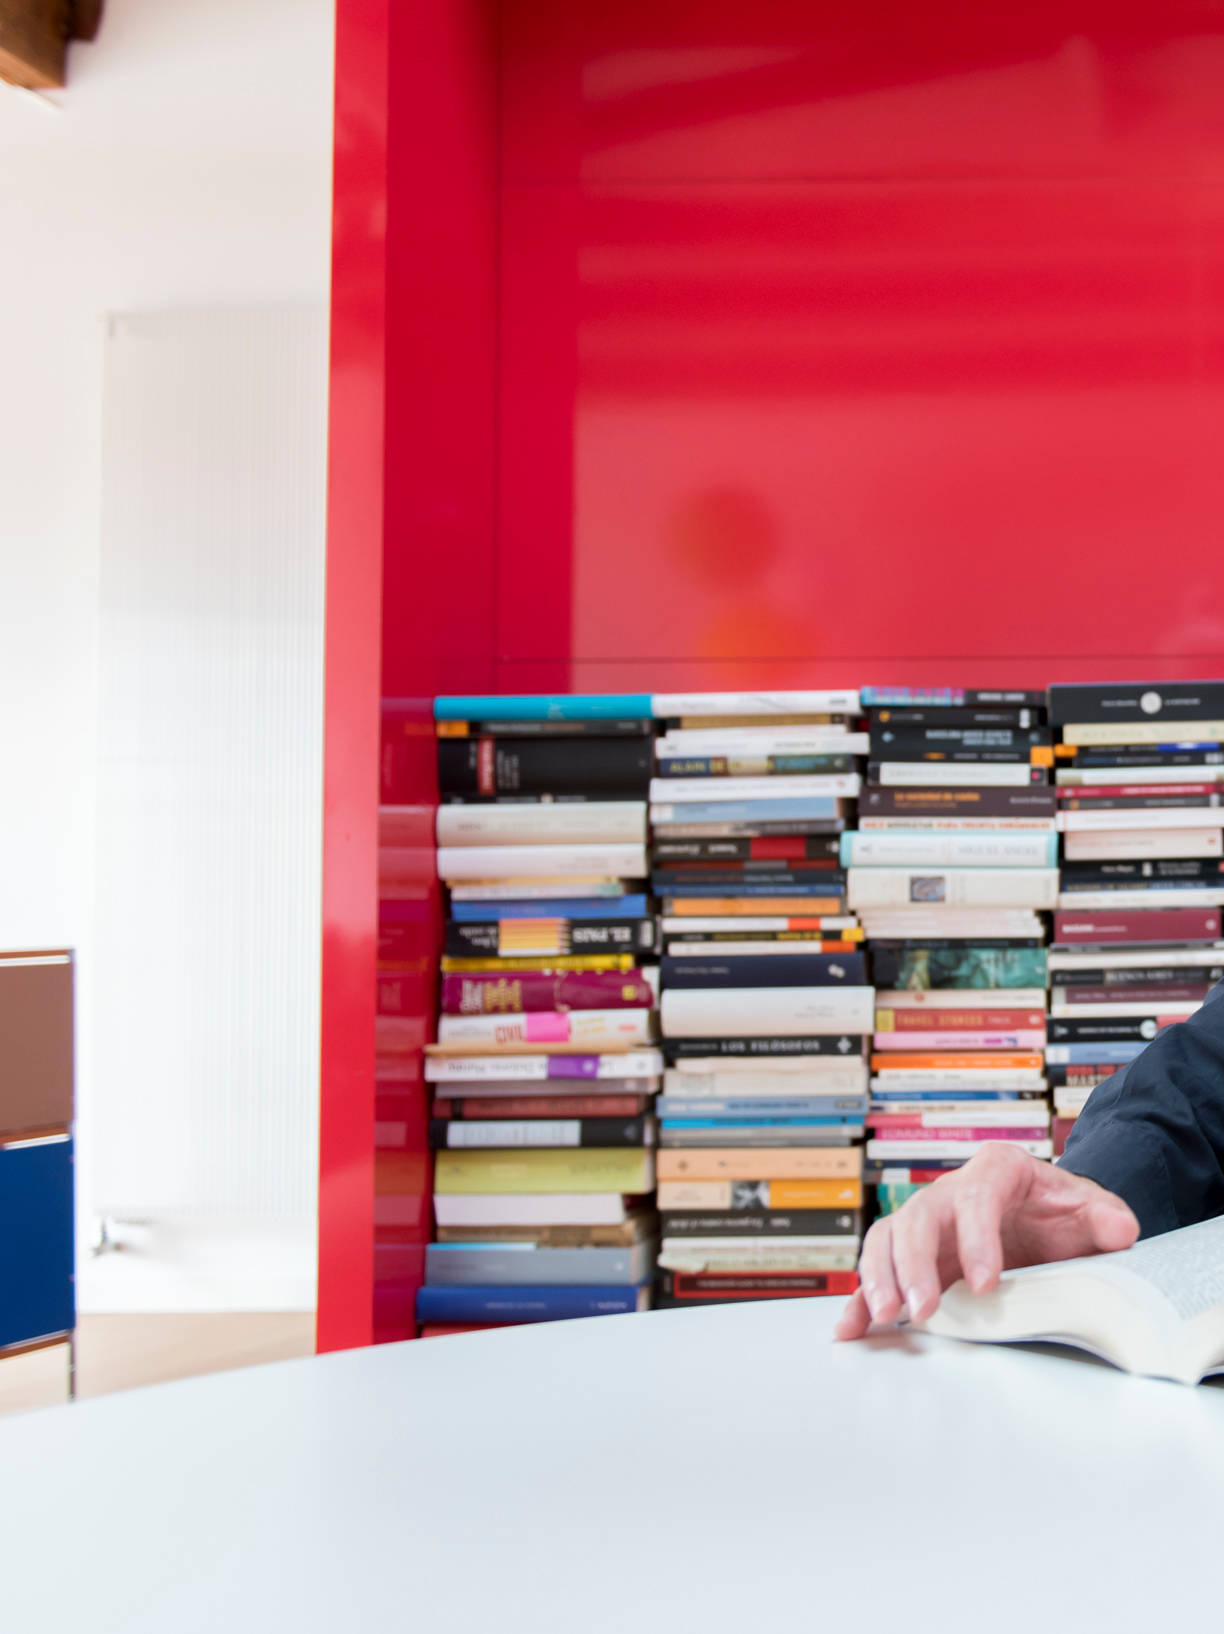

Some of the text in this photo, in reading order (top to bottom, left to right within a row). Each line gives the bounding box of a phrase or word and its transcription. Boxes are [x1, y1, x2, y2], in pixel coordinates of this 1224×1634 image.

[669, 762, 706, 774] ALAIN
[709, 759, 724, 772] DE
[613, 927, 632, 942] EL
[897, 1014, 932, 1027] TRAVEL
[939, 1014, 982, 1026] STORIES
[495, 1024, 525, 1044] CIVIL
[721, 1041, 745, 1053] LOS
[881, 1128, 972, 1140] EDMUND WHITE
